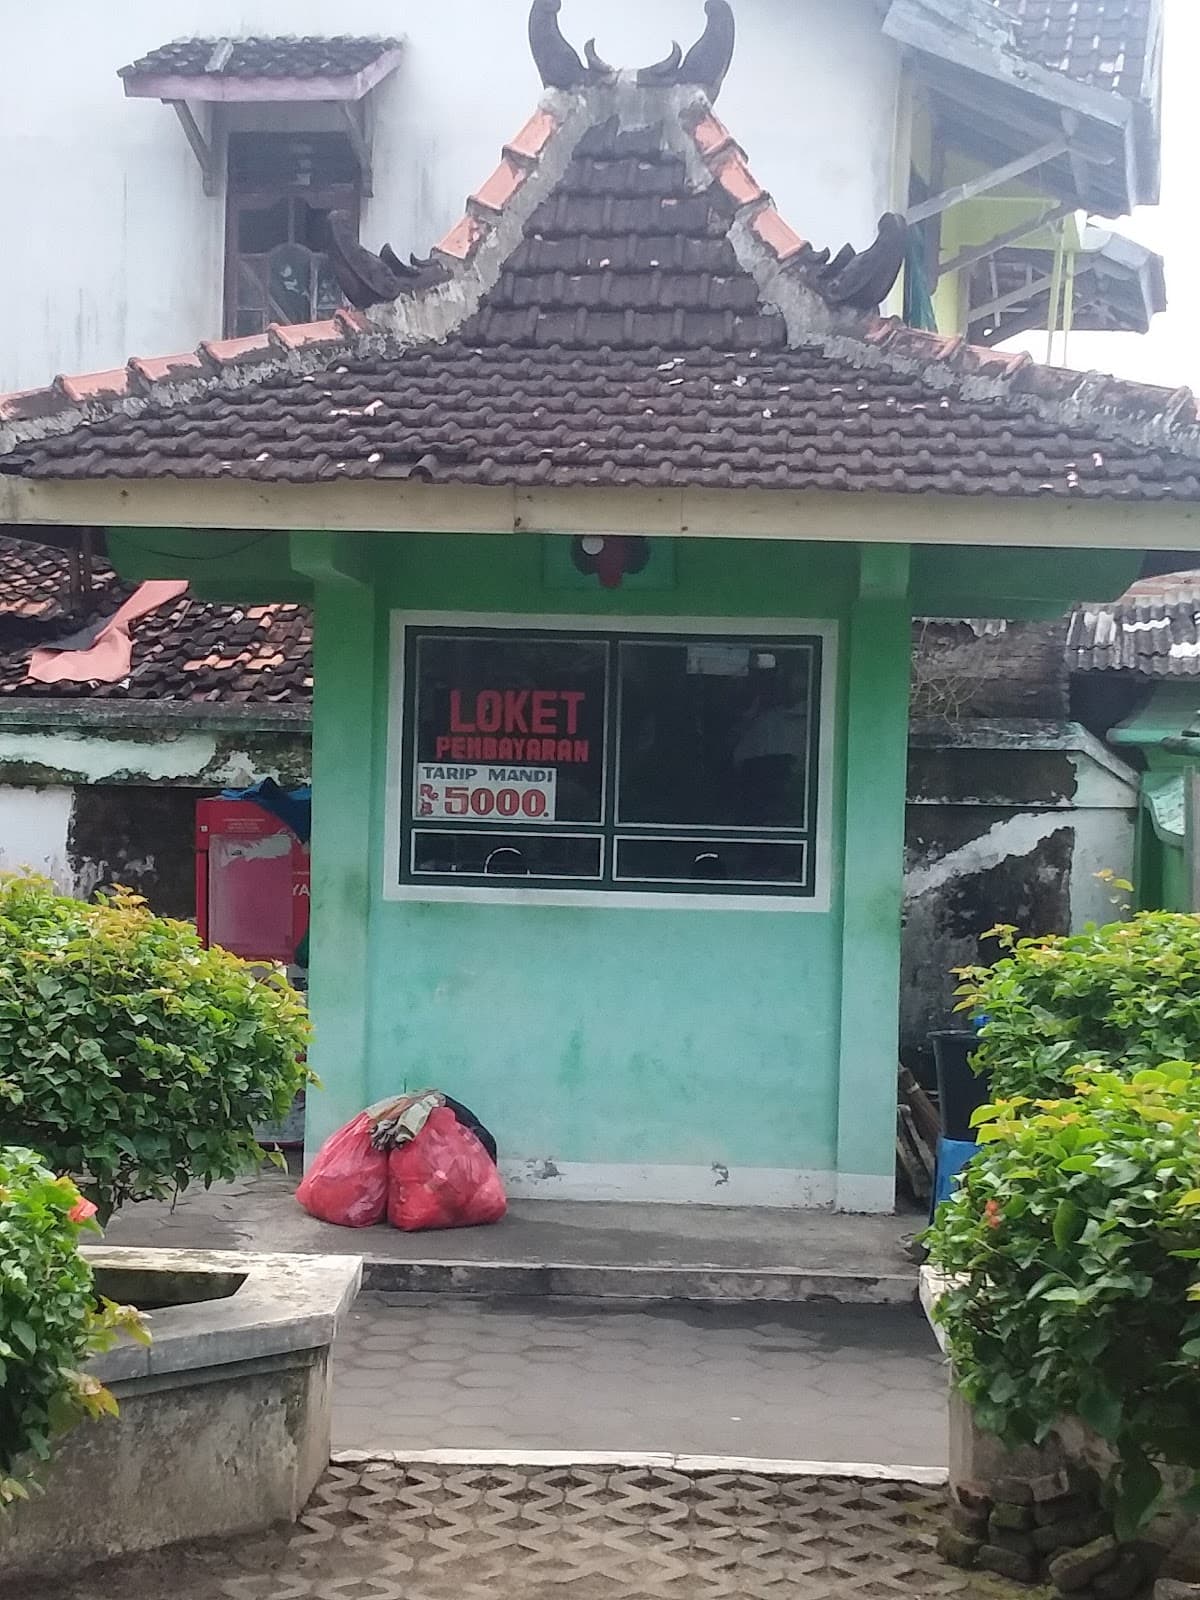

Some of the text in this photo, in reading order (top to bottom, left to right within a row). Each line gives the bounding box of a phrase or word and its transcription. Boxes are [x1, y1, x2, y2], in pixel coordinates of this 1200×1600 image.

[450, 689, 585, 735] LOKET
[422, 766, 553, 782] TARIP MANDI
